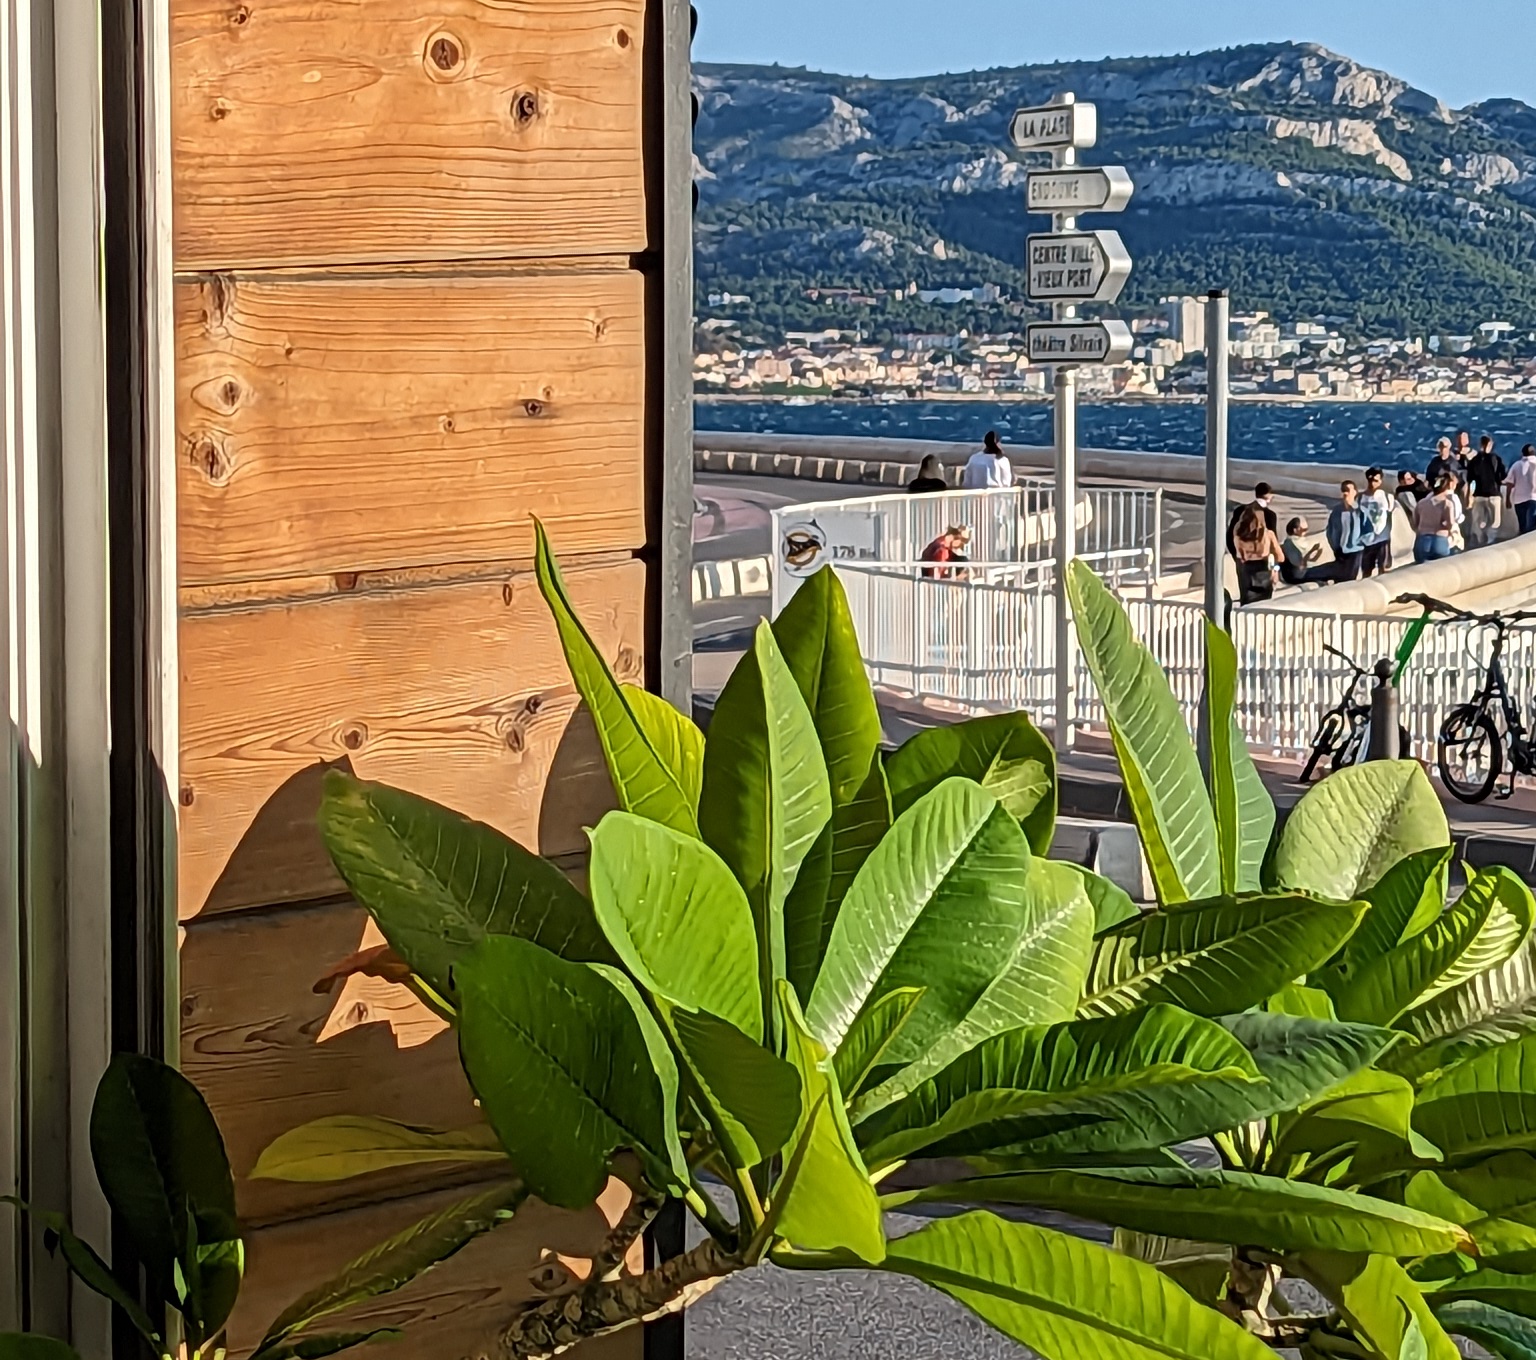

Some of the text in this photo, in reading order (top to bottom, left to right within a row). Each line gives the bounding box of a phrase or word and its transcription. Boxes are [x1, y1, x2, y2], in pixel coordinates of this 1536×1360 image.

[1023, 120, 1036, 139] LA
[1033, 242, 1096, 265] CENTRE VILLE
[1067, 267, 1092, 288] PORT
